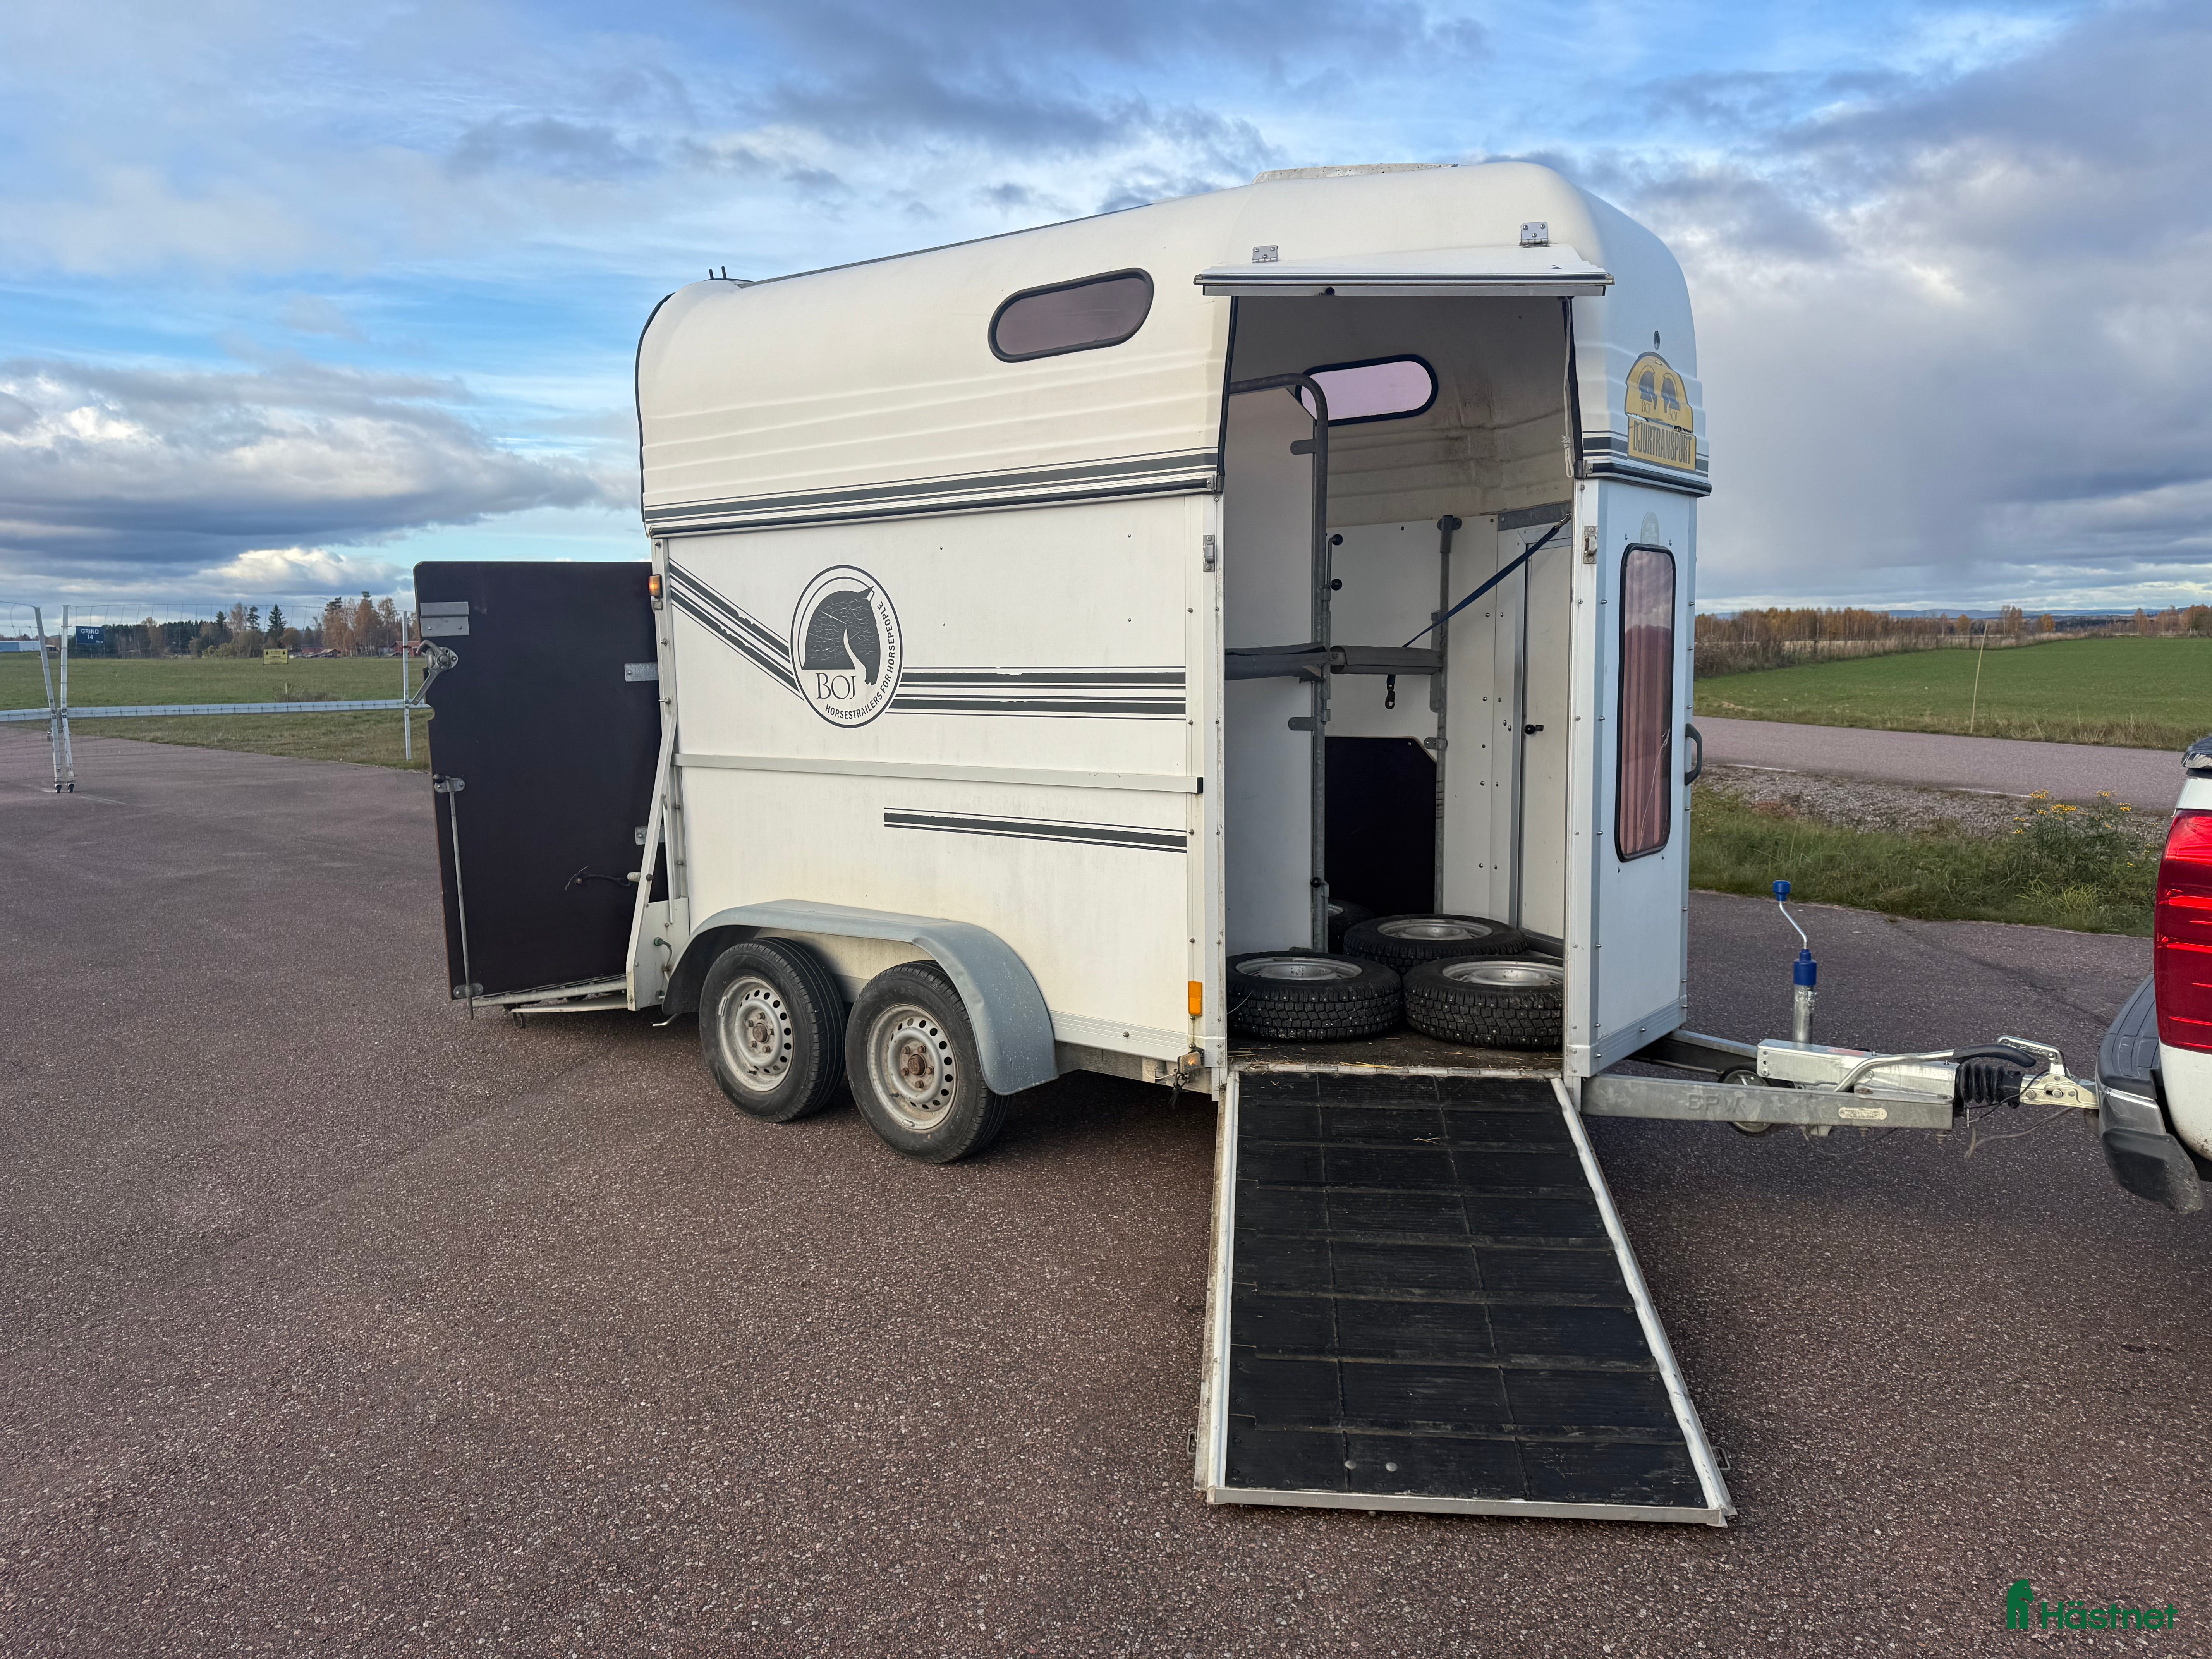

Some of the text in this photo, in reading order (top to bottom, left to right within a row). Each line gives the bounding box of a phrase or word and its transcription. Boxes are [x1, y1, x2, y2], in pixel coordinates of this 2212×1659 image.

[1633, 420, 1692, 464] DJURTRANSPORT
[825, 601, 895, 719] HORSESTRAILERS FOR HORSEPEOPLE
[815, 673, 857, 699] BOJ
